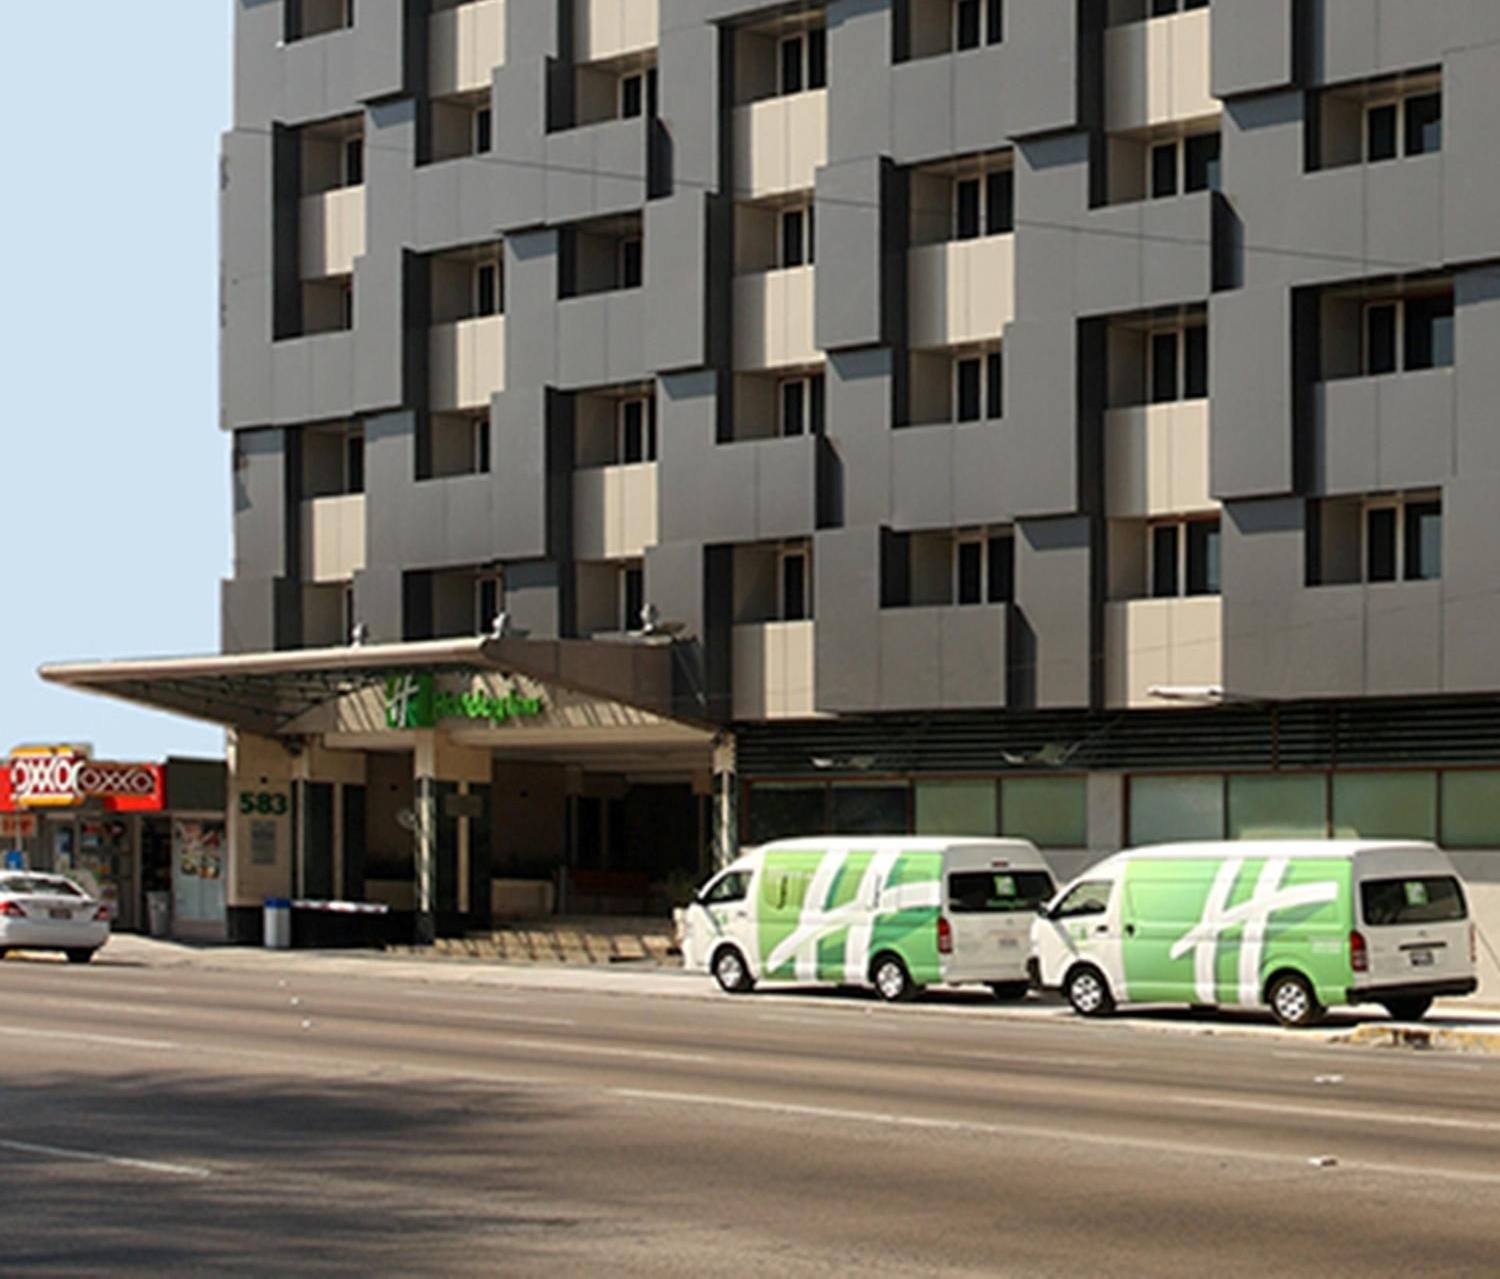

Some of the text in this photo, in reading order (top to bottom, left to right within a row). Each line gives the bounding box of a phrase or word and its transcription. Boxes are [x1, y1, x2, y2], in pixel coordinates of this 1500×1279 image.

[11, 757, 75, 794] OXXO
[79, 768, 154, 794] OXXO
[240, 791, 288, 816] 583
